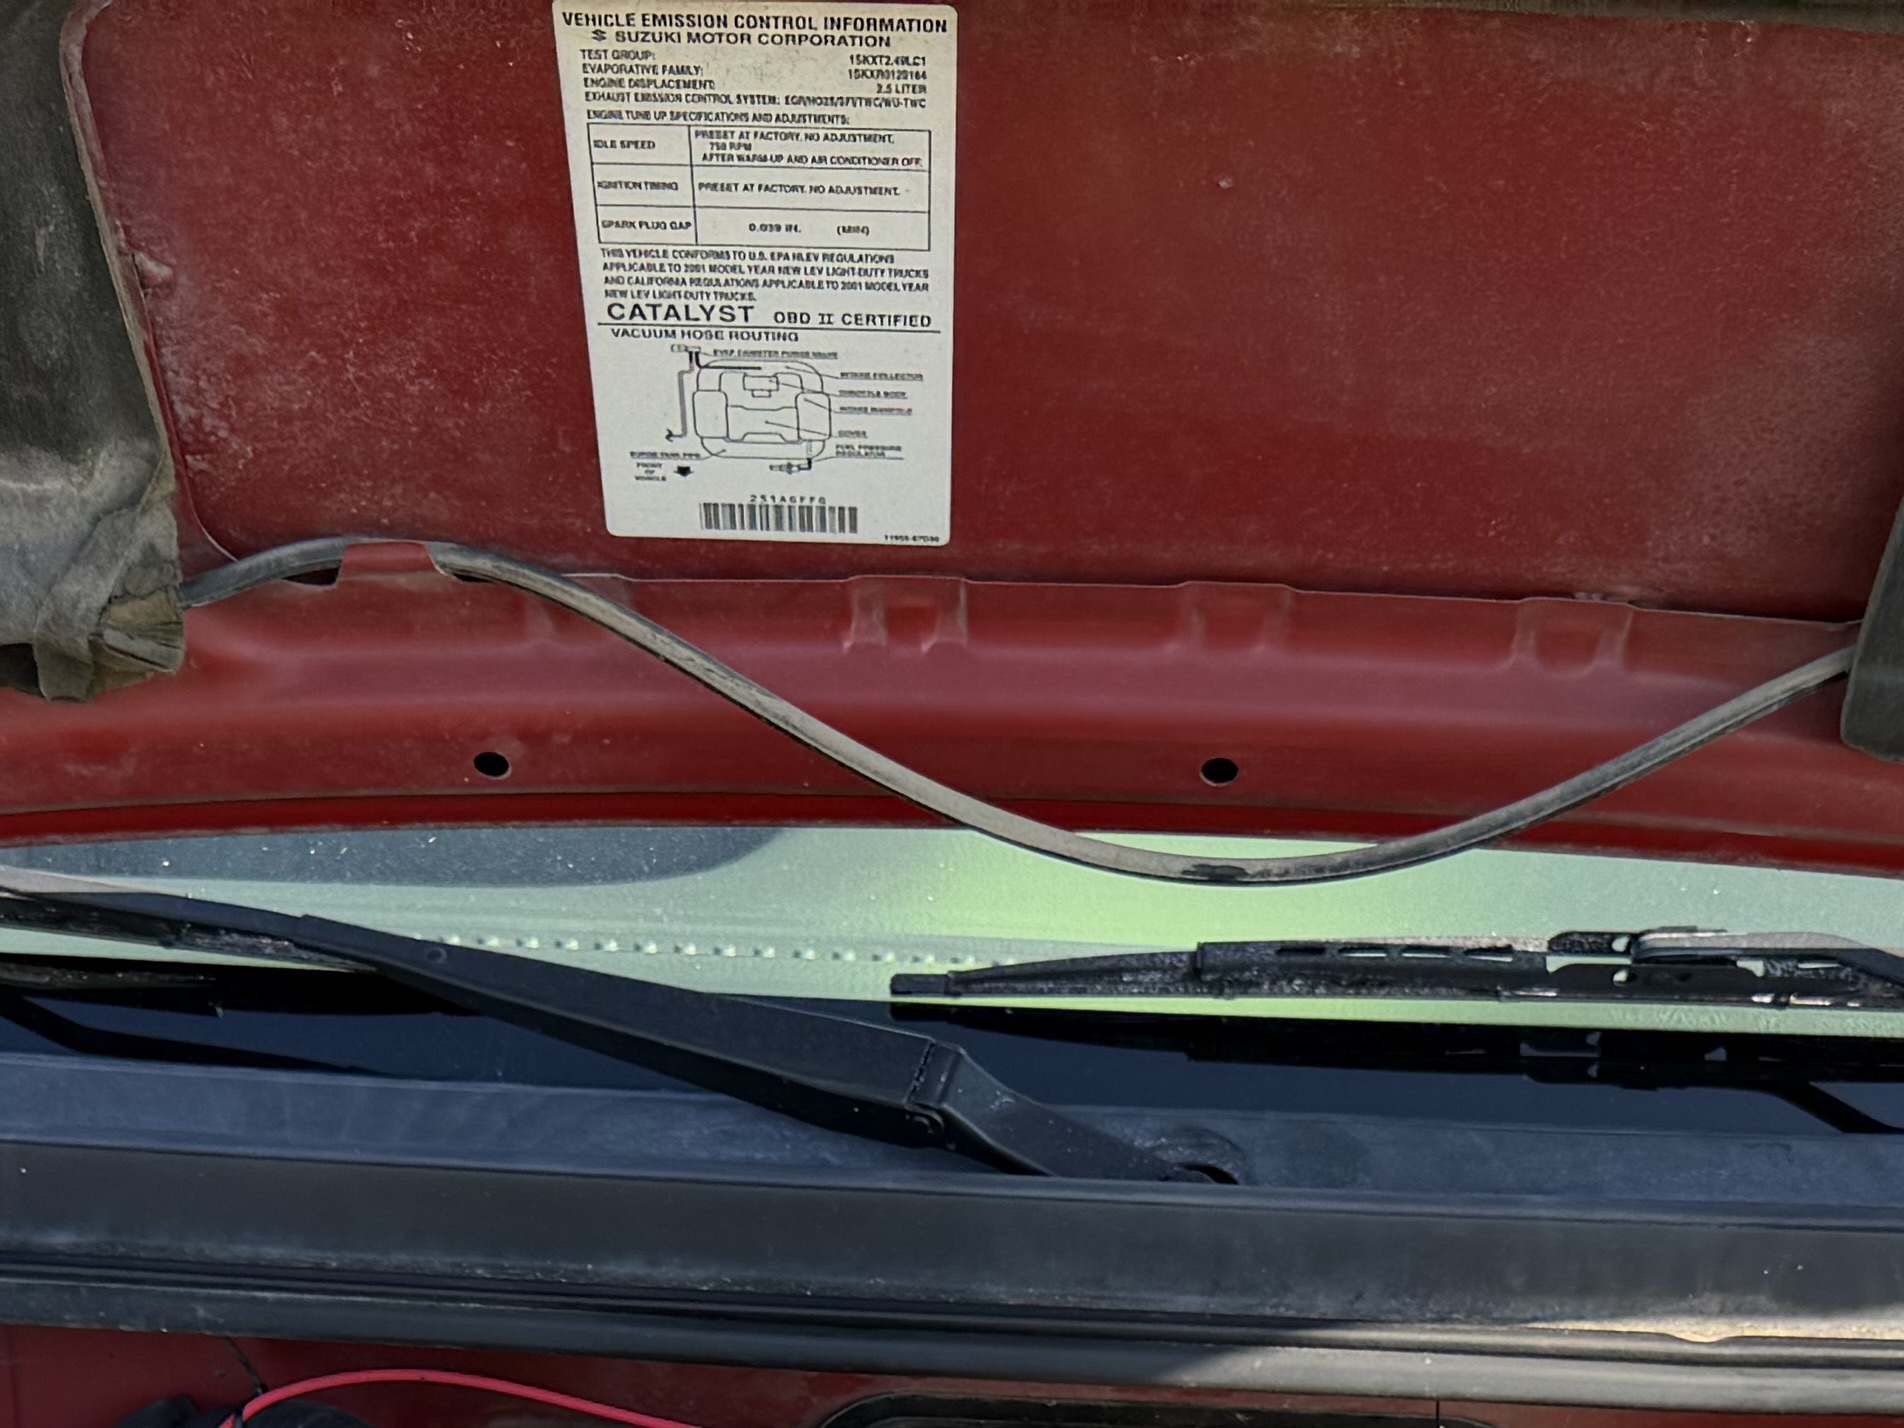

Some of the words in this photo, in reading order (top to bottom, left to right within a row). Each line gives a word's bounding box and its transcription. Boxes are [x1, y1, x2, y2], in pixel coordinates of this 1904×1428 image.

[562, 12, 636, 27] VEHICLE
[641, 13, 728, 29] EMISSION
[734, 14, 818, 30] CONTROL
[824, 17, 947, 33] INFORMATION
[615, 31, 681, 43] SUZUKI
[687, 32, 752, 44] MOTOR
[758, 33, 891, 47] CORPORATION
[581, 49, 608, 60] TEST
[612, 50, 655, 61] GROUP:
[582, 64, 658, 75] EVAPORATIVE
[662, 65, 703, 76] FAMILY:
[584, 78, 625, 88] ENGINE
[876, 84, 892, 94] 2.5
[895, 84, 927, 94] LITER
[585, 92, 630, 103] EXHAUST
[634, 92, 682, 103] EMISSION
[685, 93, 734, 104] CONTROL
[736, 94, 780, 105] SYSTEM:
[587, 110, 624, 120] ENGINE
[626, 110, 651, 120] TUNE
[653, 111, 667, 120] UP
[670, 111, 749, 122] SPECIFICATIONS
[752, 113, 772, 123] AND
[695, 130, 736, 140] PRESET
[738, 131, 751, 140] AT
[804, 132, 820, 142] NO
[593, 139, 617, 149] IDLE
[620, 140, 656, 149] SPEED
[729, 142, 752, 151] RPM
[702, 153, 734, 162] AFTER
[787, 155, 808, 164] AND
[811, 155, 827, 165] AIR
[830, 156, 899, 166] CONDITIONER
[597, 181, 642, 190] IGNITION
[645, 181, 678, 191] TIMING
[698, 182, 739, 192] PRESET
[742, 183, 754, 192] AT
[809, 184, 825, 194] NO
[601, 220, 636, 229] SPARK
[639, 220, 667, 230] PLUG
[670, 221, 691, 230] GAP
[601, 248, 623, 258] THIS
[627, 249, 669, 259] VEHICLE
[672, 250, 730, 261] CONFORMS
[732, 251, 746, 261] TO
[770, 252, 790, 262] EPA
[822, 253, 894, 264] REGULATIONS
[603, 262, 666, 273] APPLICABLE
[668, 263, 681, 273] TO
[708, 264, 745, 274] MODEL
[748, 265, 775, 275] YEAR
[778, 266, 801, 275] NEW
[803, 266, 824, 276] LEV
[888, 269, 928, 279] TRUCKS
[604, 276, 625, 286] AND
[627, 277, 686, 287] CALIFORNIA
[689, 278, 759, 288] REGULATIONS
[762, 279, 824, 290] APPLICABLE
[826, 281, 839, 290] TO
[865, 282, 900, 291] MODEL
[902, 283, 929, 292] YEAR
[604, 289, 628, 299] NEW
[630, 290, 650, 299] LEV
[607, 303, 754, 323] CATALYST
[773, 311, 811, 325] OBD
[818, 313, 834, 325] II
[841, 313, 932, 328] CERTIFIED
[610, 328, 676, 340] VACUUM
[680, 329, 724, 341] HOSE
[728, 330, 799, 342] ROUTING
